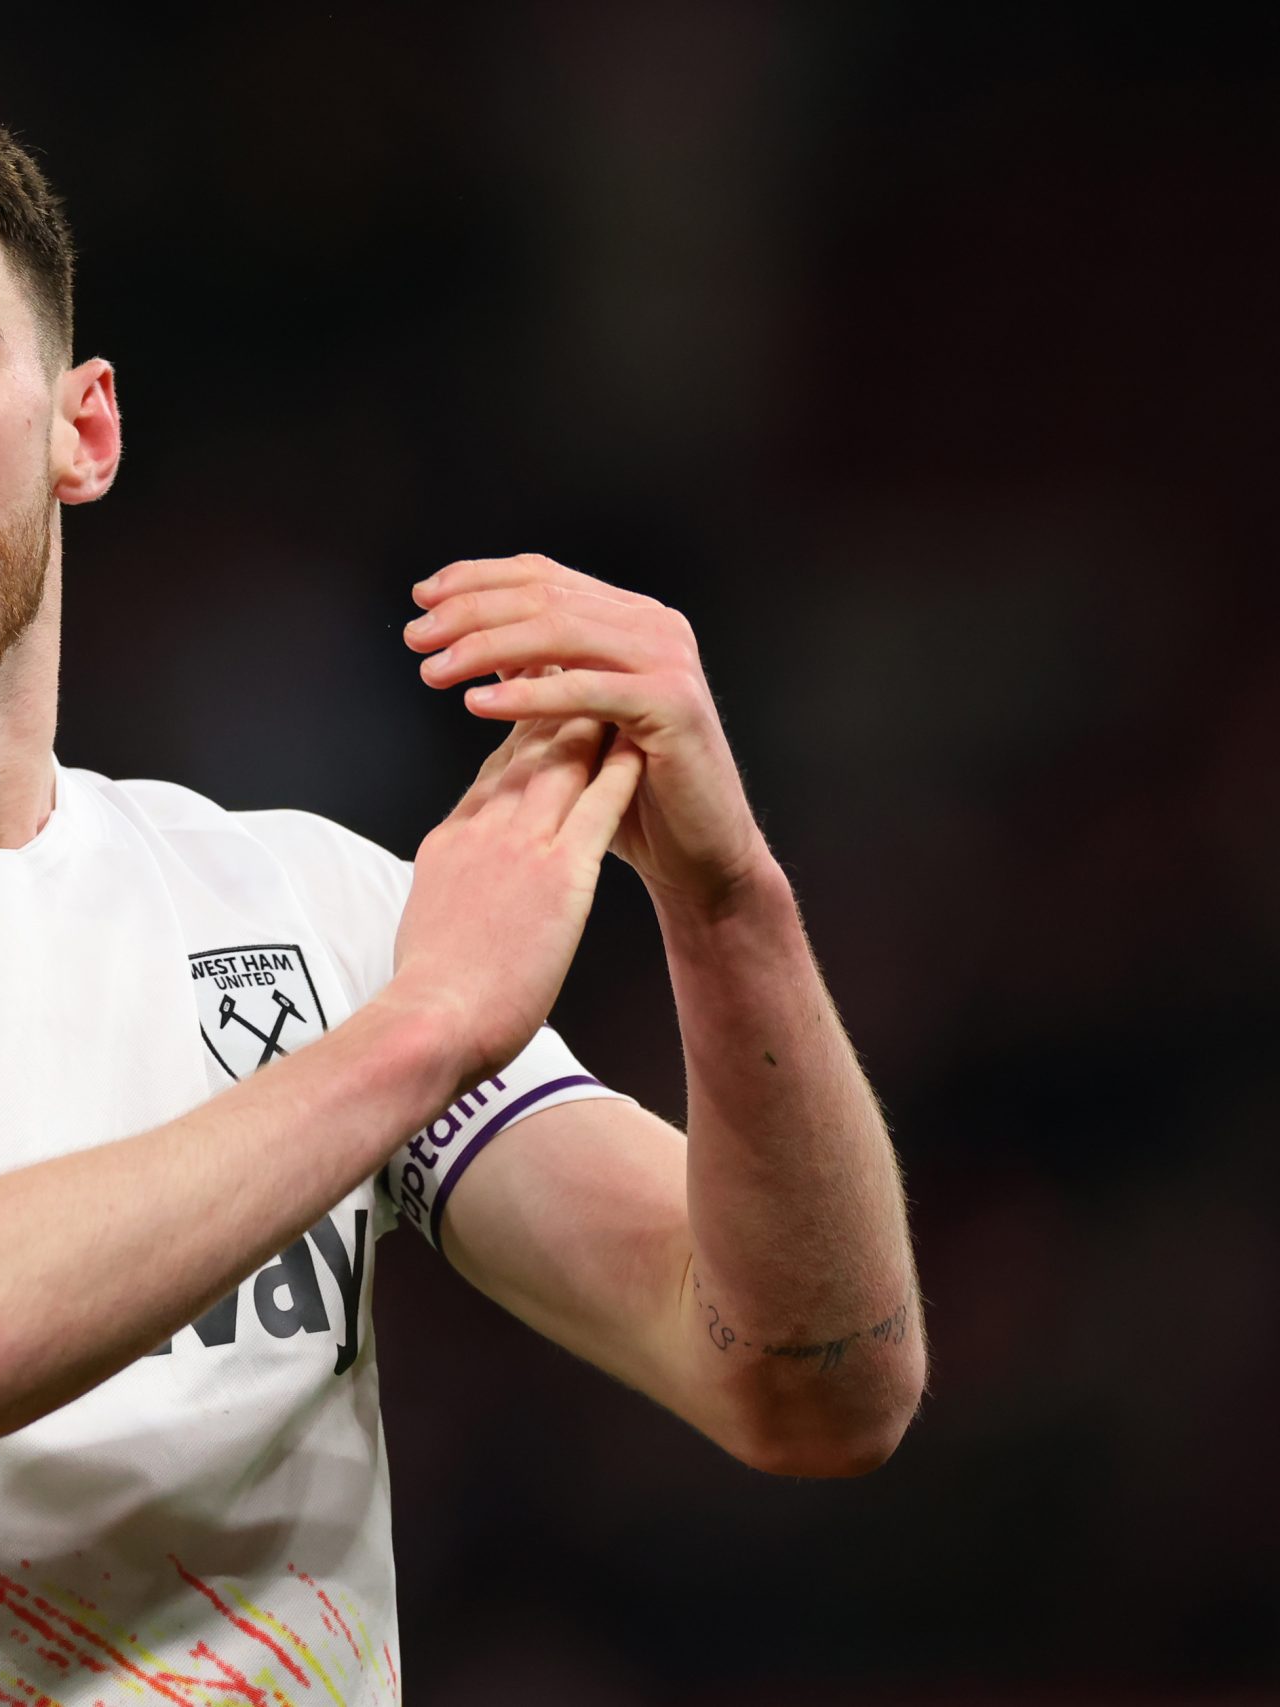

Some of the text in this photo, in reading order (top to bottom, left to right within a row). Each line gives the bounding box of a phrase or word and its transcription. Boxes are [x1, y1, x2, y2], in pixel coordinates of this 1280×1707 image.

[191, 953, 294, 980] WEST HAM
[214, 971, 276, 990] UNITED
[400, 1075, 507, 1225] aptain
